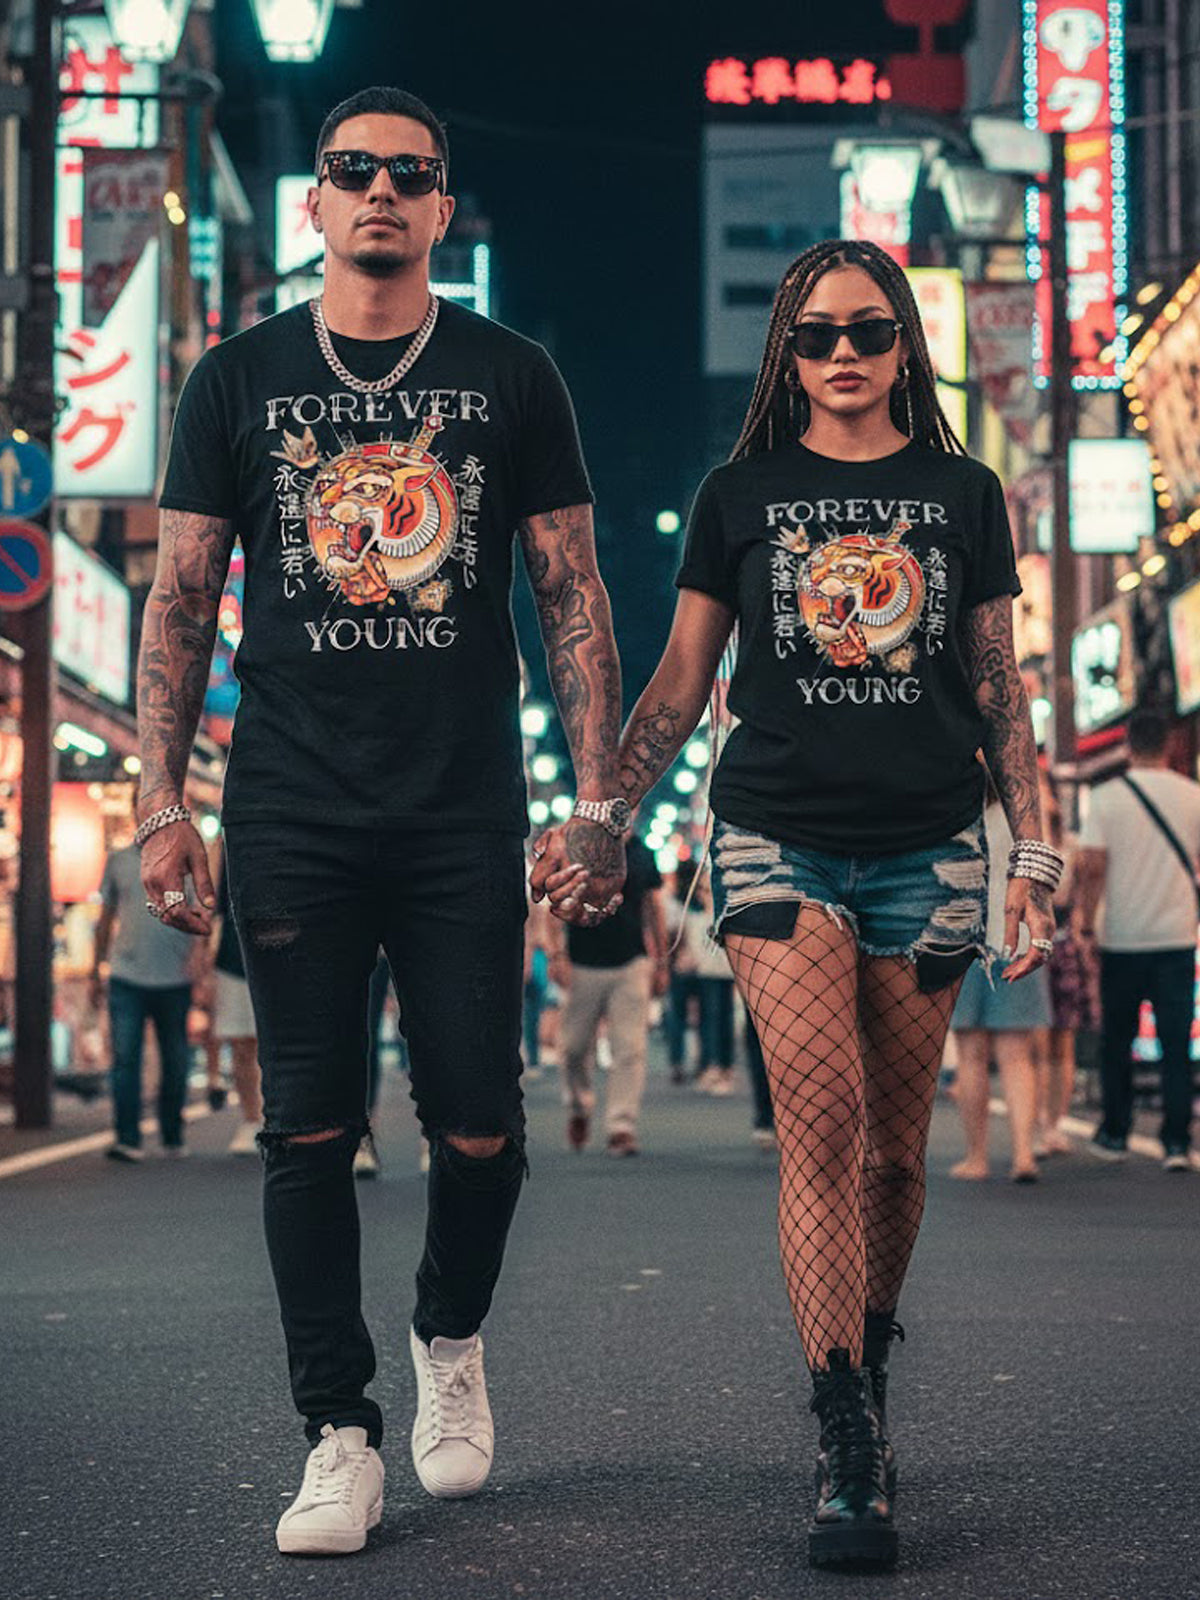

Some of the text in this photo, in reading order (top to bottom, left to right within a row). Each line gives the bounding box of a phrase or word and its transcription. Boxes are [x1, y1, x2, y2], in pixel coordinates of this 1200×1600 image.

[265, 389, 490, 430] FOREVER
[766, 498, 948, 526] FOREVER
[304, 616, 459, 652] YOUNG
[796, 676, 923, 705] YOUNG
